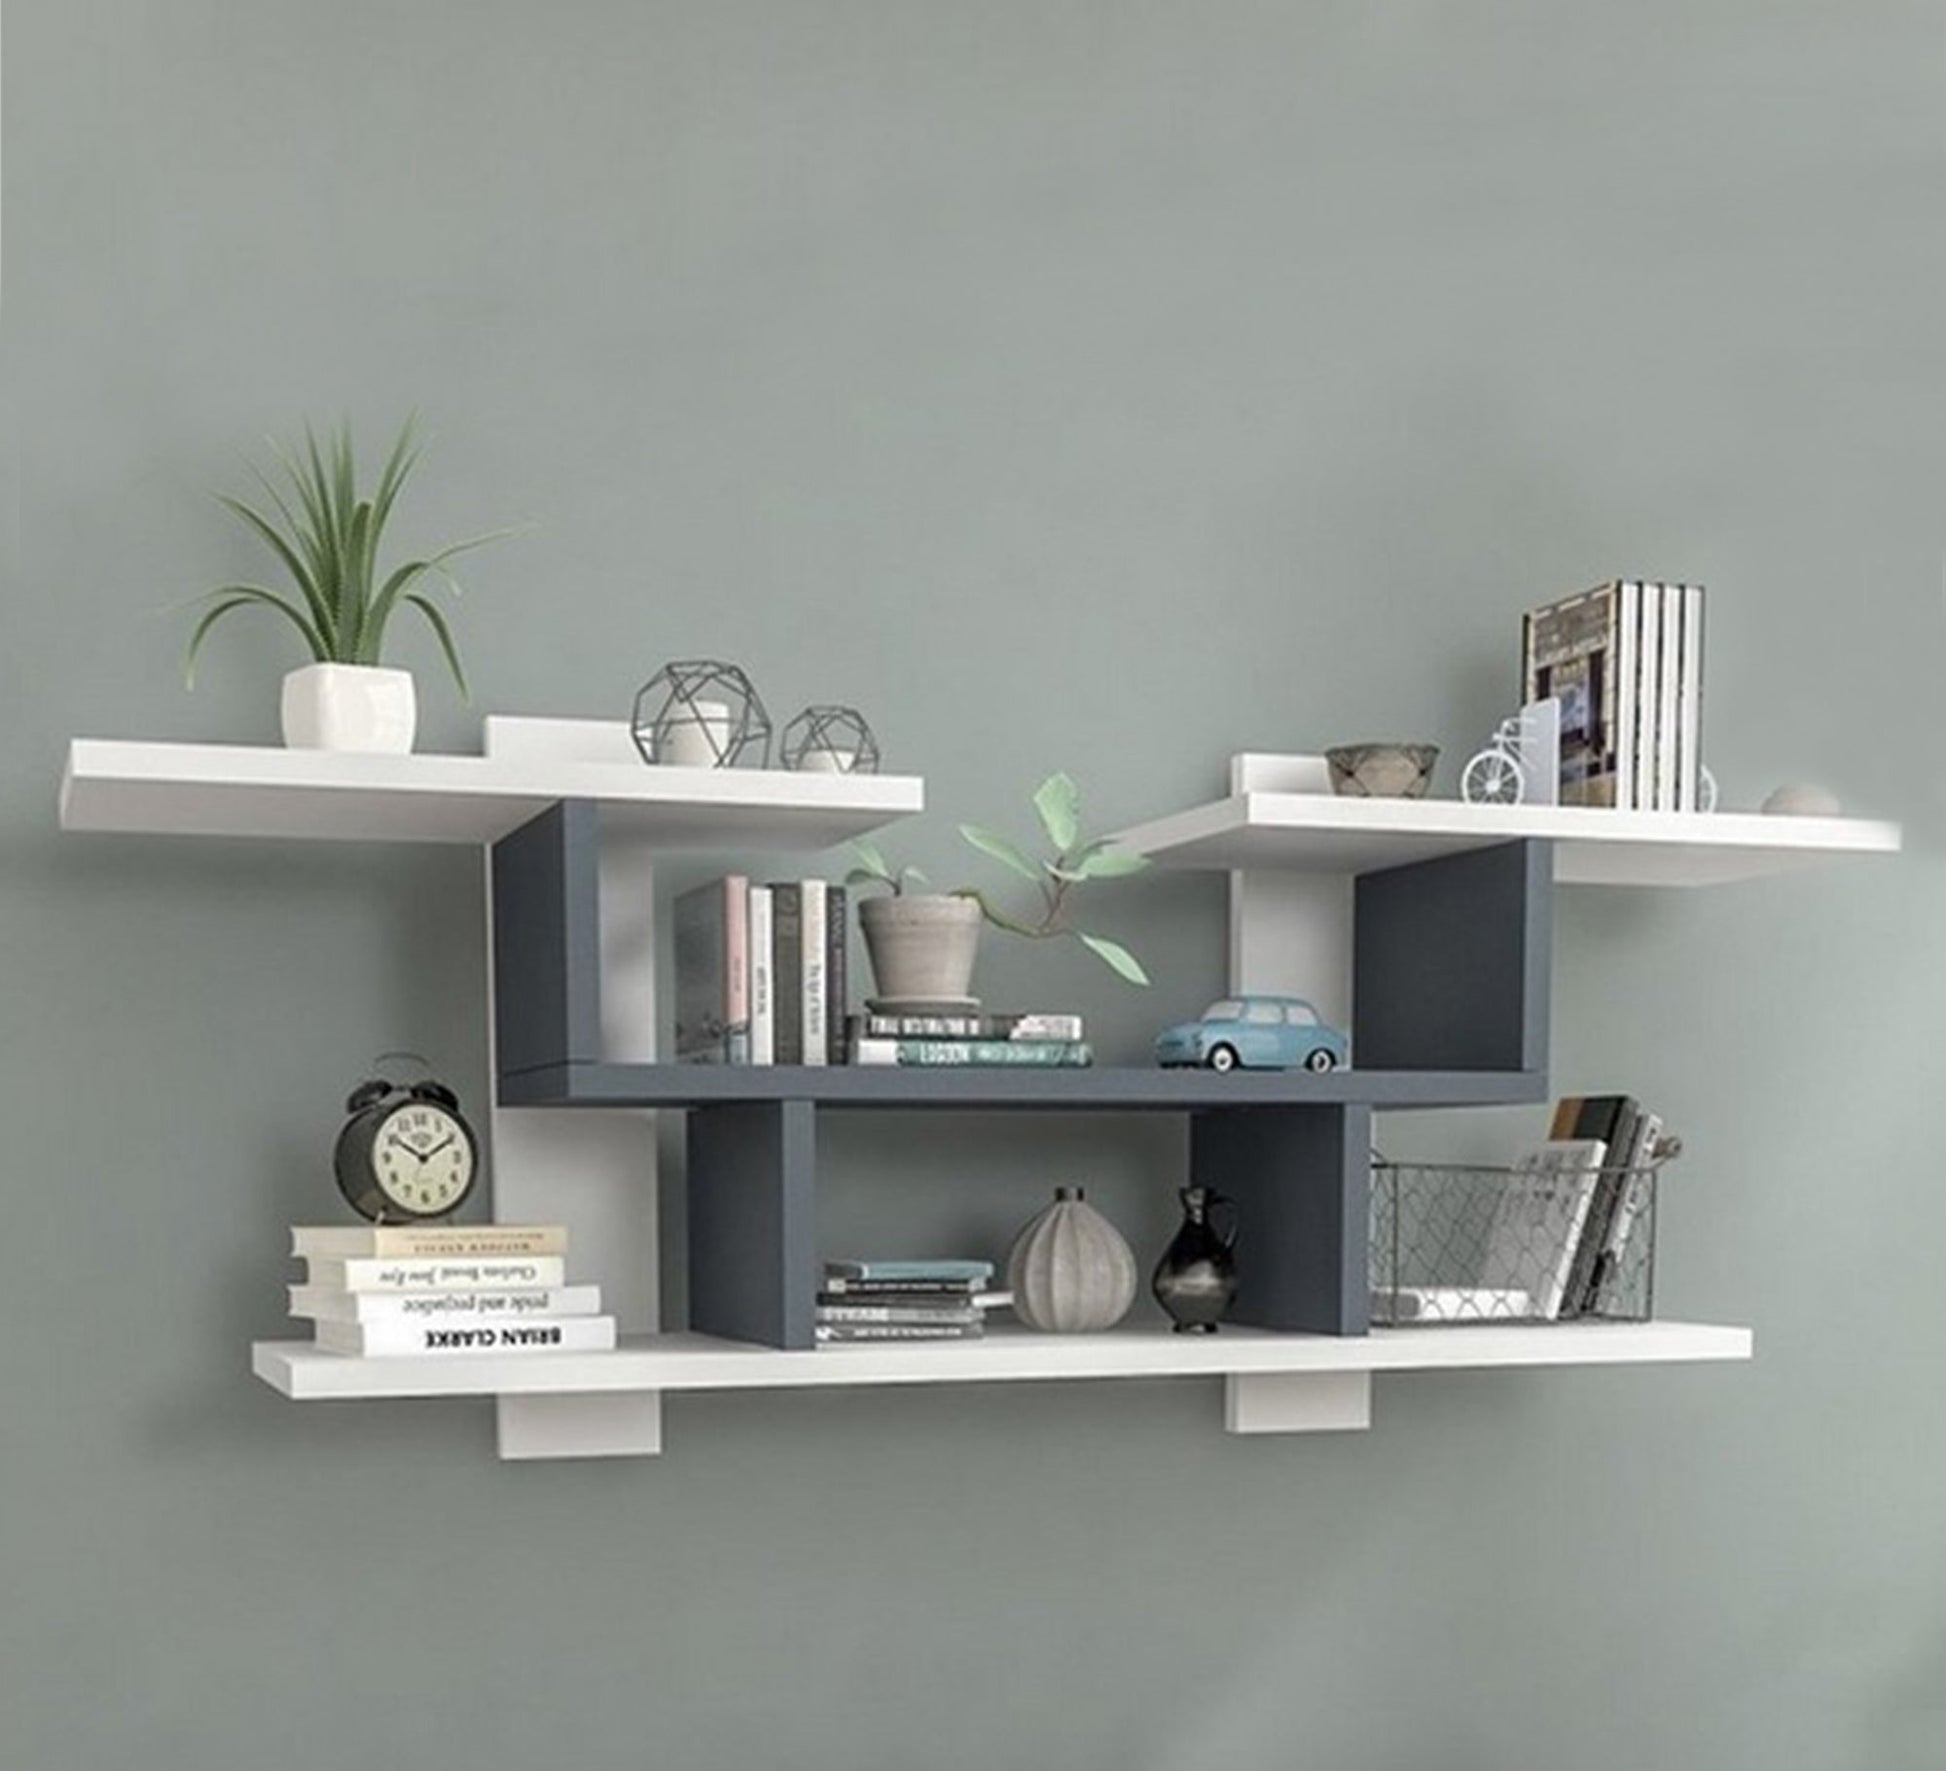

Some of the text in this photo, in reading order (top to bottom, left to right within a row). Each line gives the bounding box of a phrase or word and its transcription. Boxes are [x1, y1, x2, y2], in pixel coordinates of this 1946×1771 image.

[403, 1293, 550, 1317] pride and prejudice
[425, 1327, 562, 1348] BRIAN CLARKE
